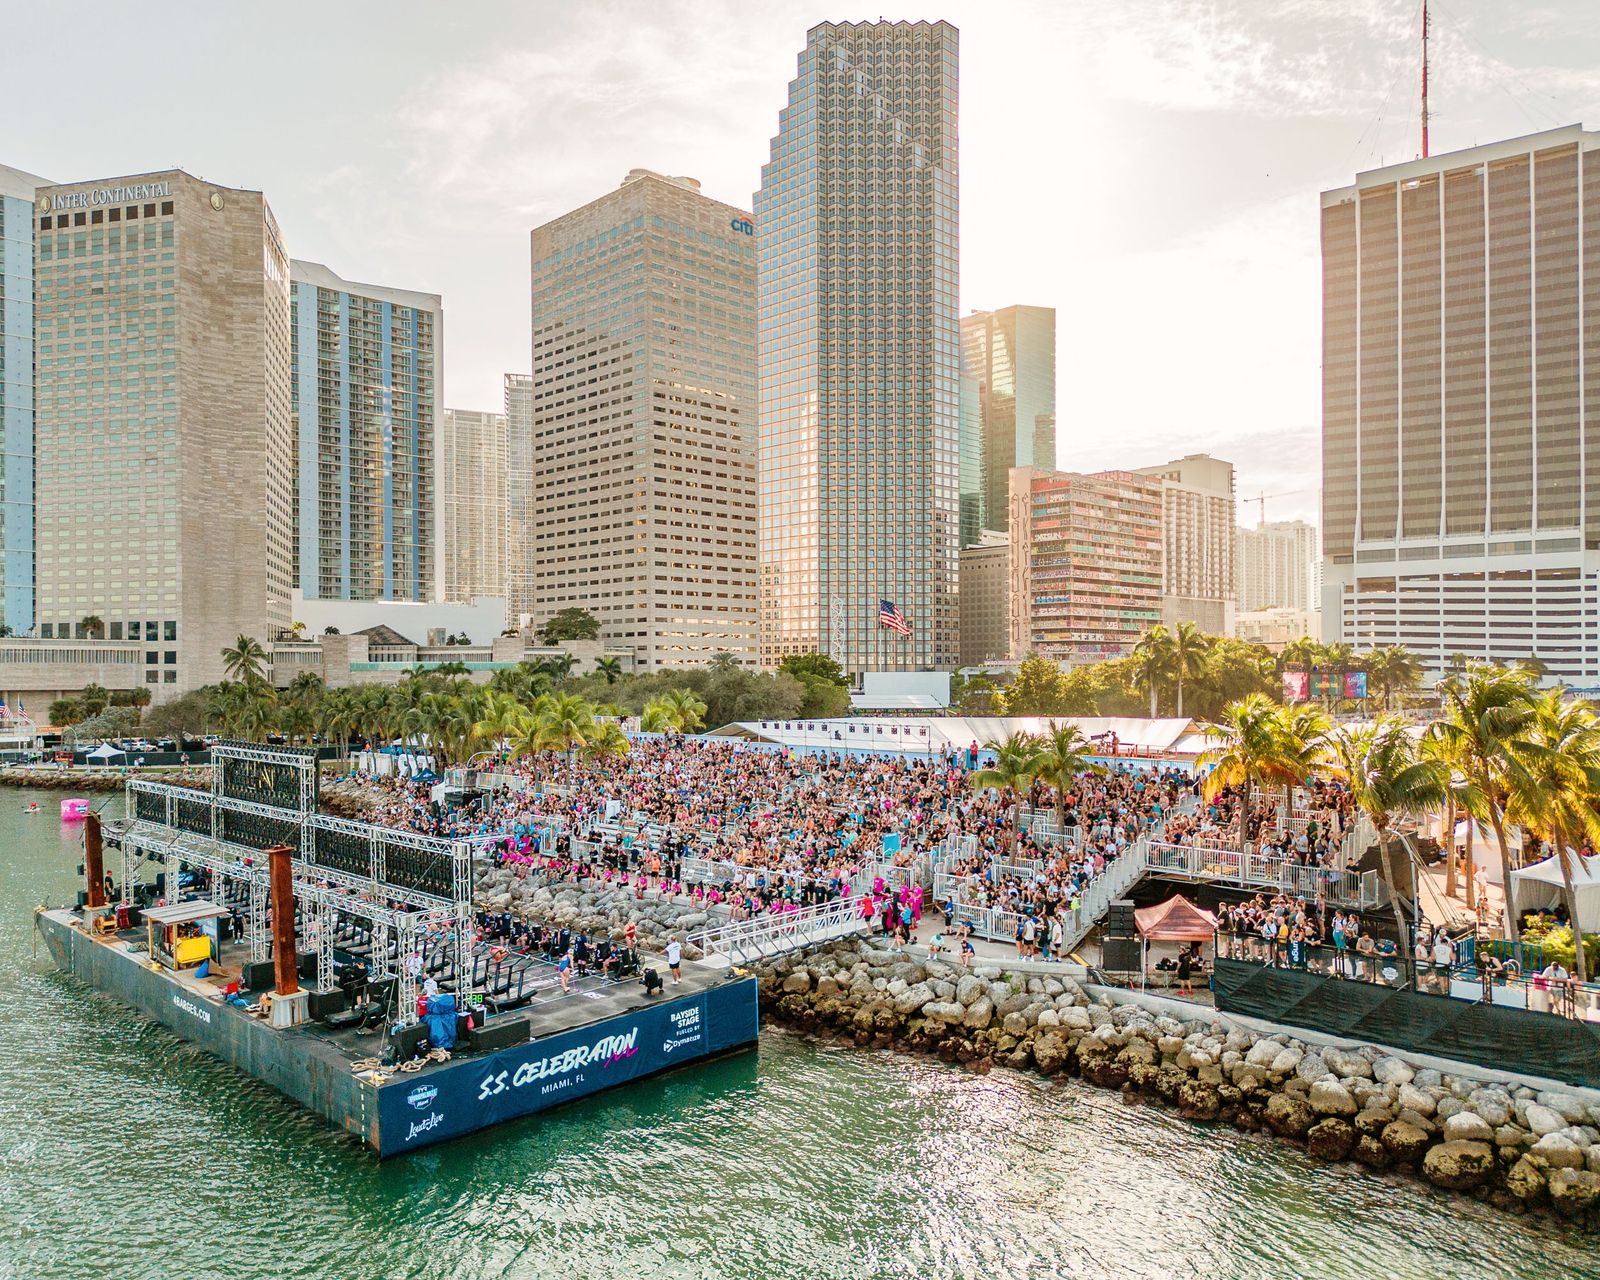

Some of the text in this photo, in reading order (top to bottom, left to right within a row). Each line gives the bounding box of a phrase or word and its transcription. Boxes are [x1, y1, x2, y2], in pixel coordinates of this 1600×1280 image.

[53, 181, 172, 210] INTER CONTINENTAL
[731, 217, 753, 236] citi
[173, 994, 211, 1024] 4BARGES.COM
[670, 1006, 699, 1022] BAYSIDE
[677, 1014, 700, 1028] STAGE
[477, 1027, 639, 1100] S.S. CELEBRATION
[541, 1073, 585, 1095] MIAMI, FL
